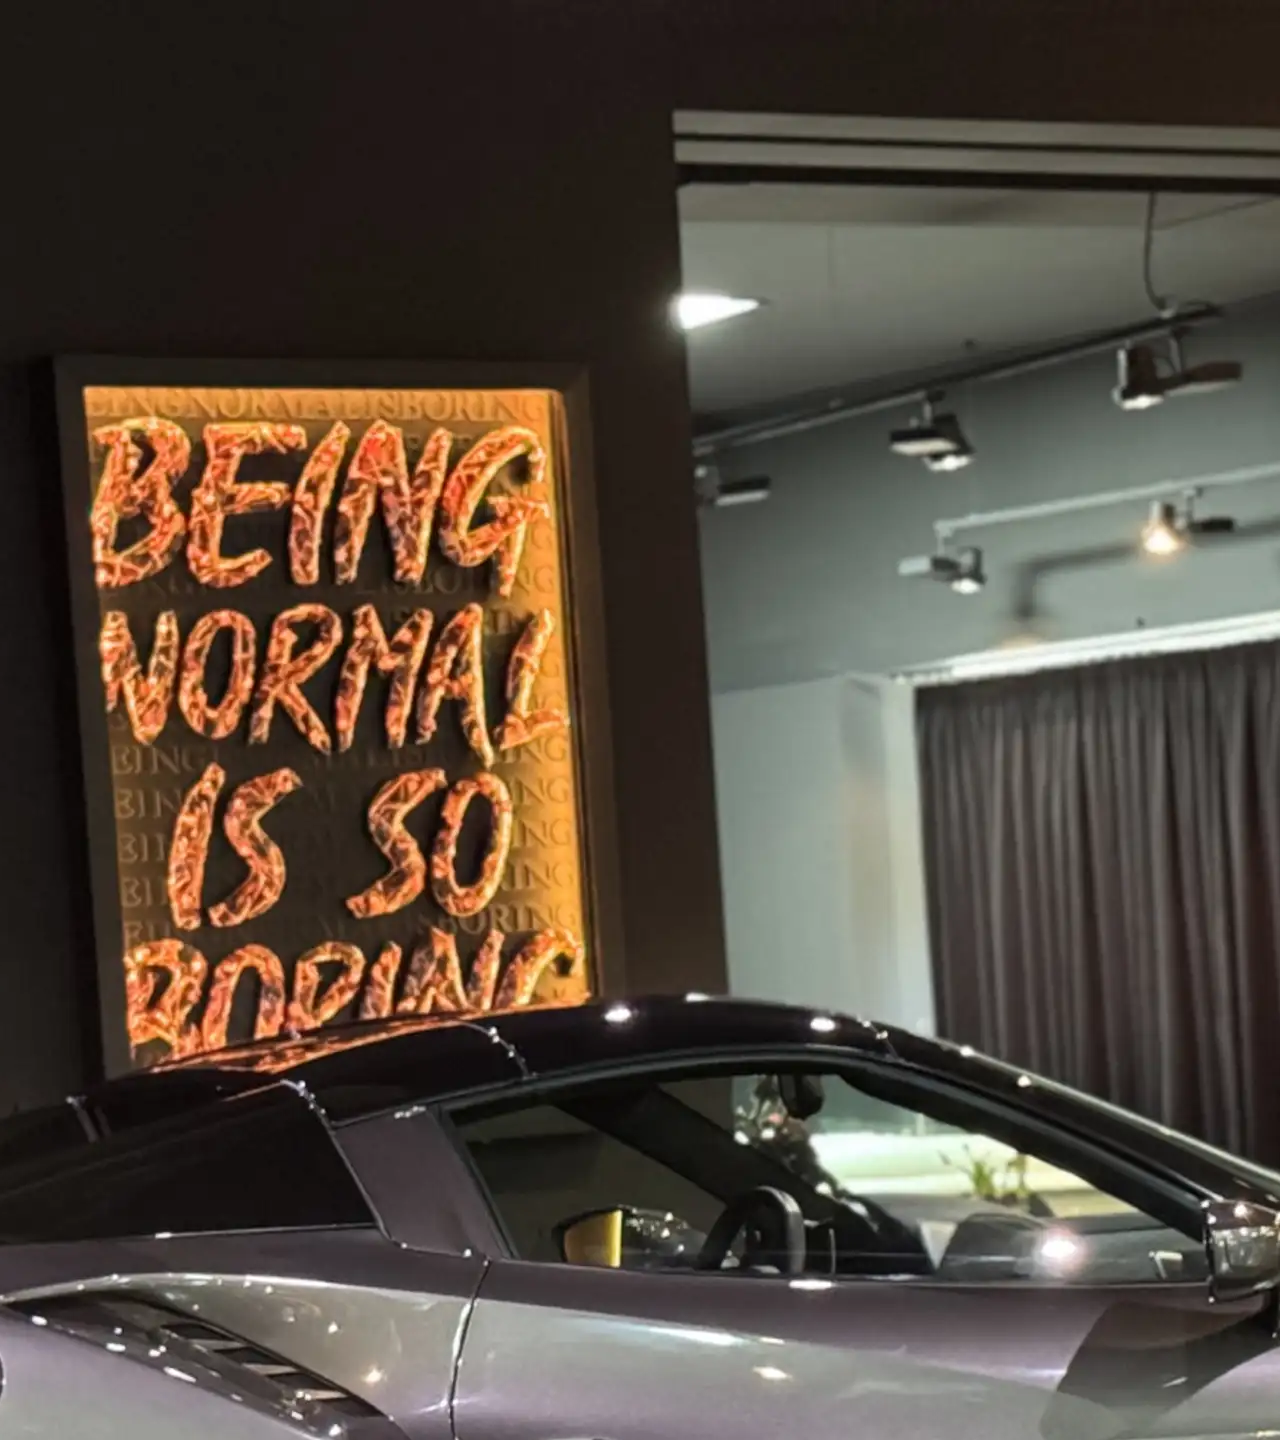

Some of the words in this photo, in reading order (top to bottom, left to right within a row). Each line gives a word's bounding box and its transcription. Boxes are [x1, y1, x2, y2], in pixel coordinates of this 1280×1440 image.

[89, 417, 549, 599] BEING
[99, 602, 570, 768] NORMAL
[167, 763, 303, 931] IS
[346, 767, 513, 919] SO
